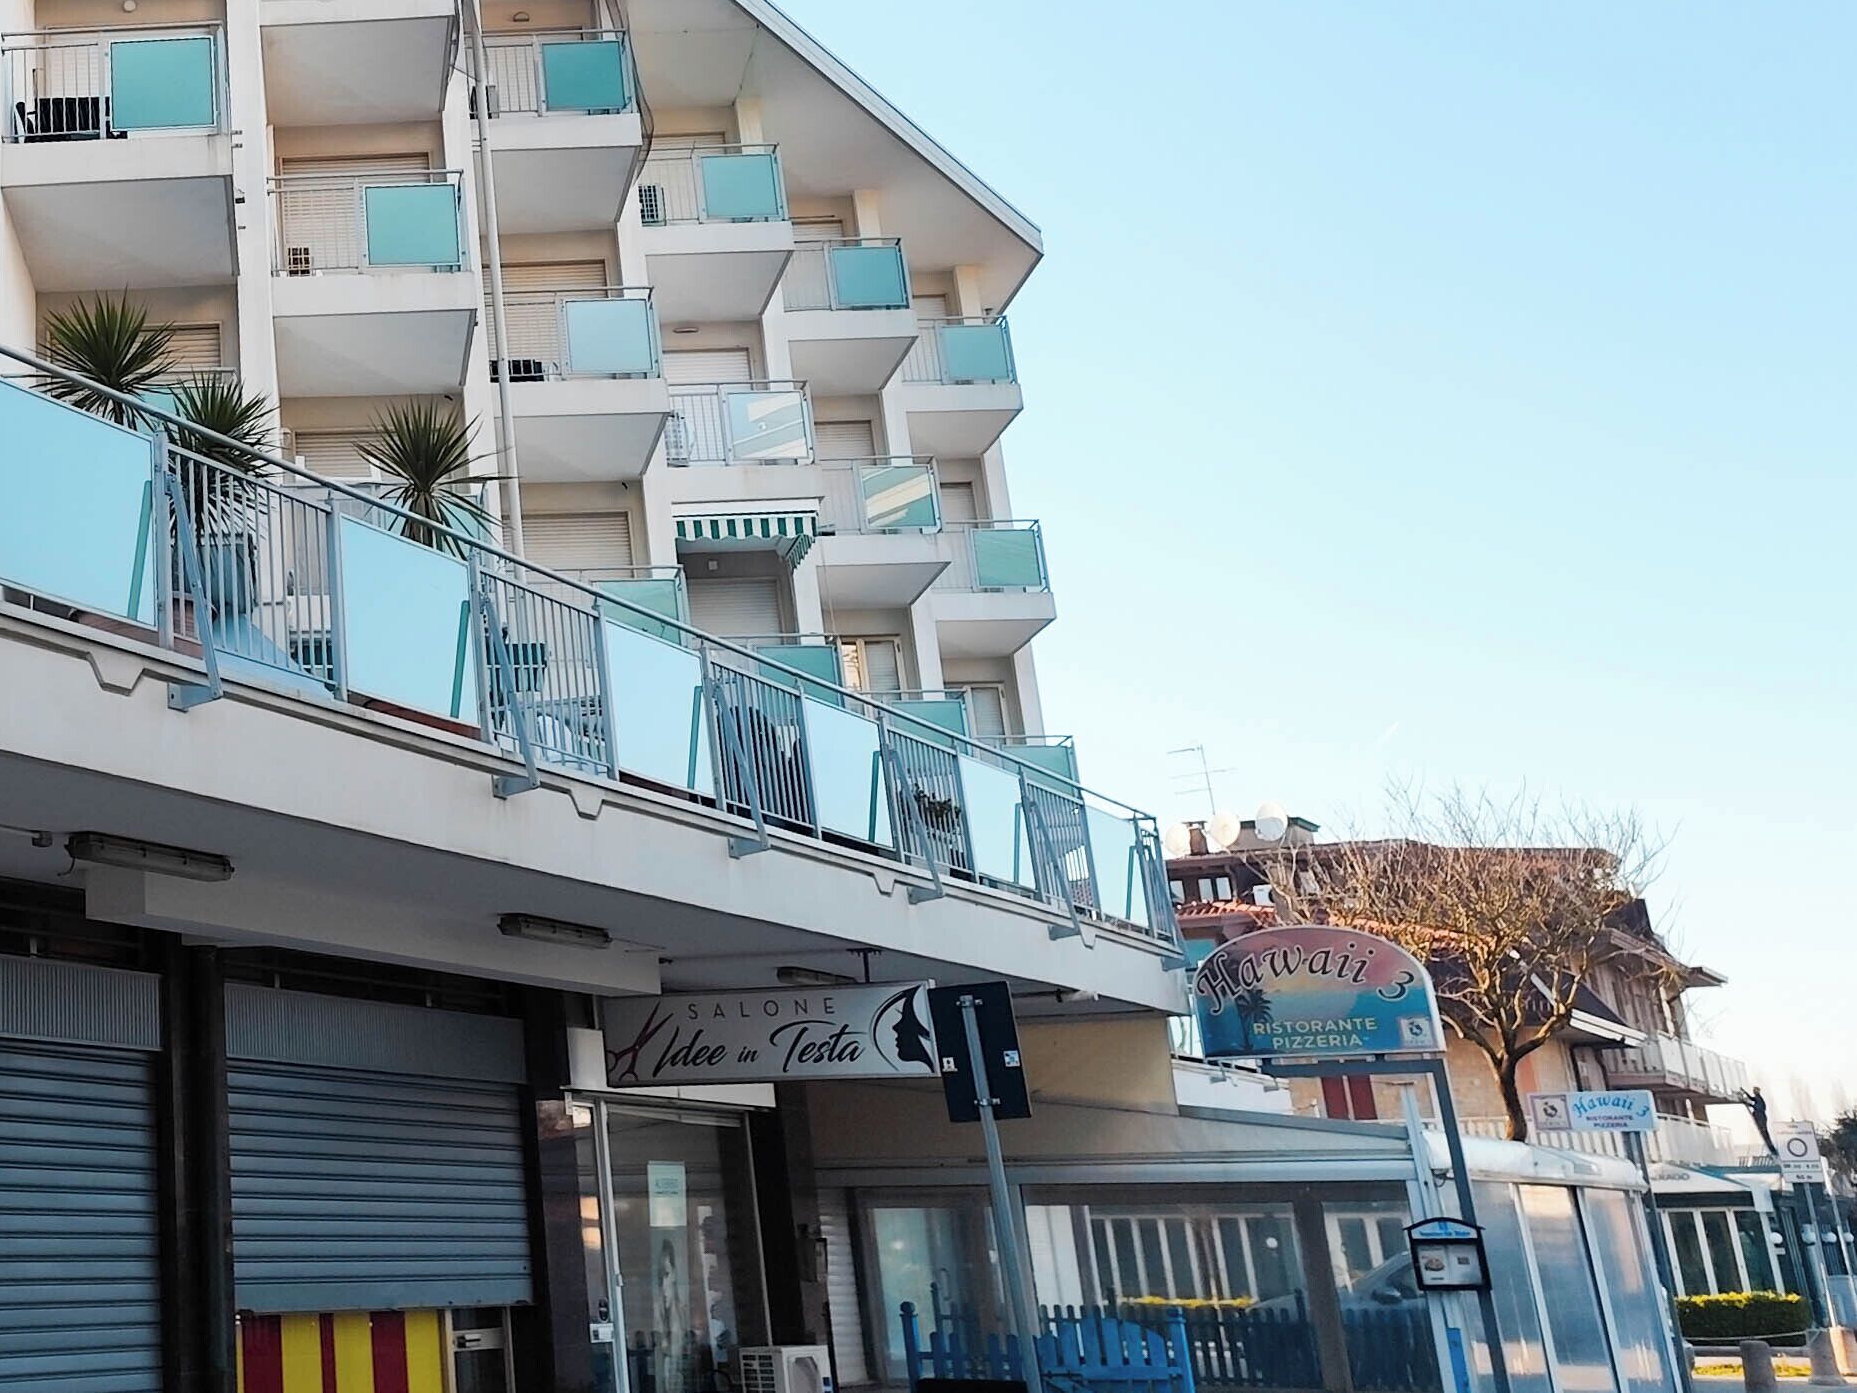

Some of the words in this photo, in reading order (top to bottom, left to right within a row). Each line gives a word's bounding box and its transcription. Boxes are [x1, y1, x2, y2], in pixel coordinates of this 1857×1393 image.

[1197, 943, 1374, 1014] Hawaii
[1377, 970, 1415, 1001] 3
[688, 996, 835, 1020] SALONE
[1253, 1017, 1378, 1036] RISTORANTE
[652, 1025, 728, 1078] Idee
[737, 1047, 759, 1064] in
[769, 1019, 869, 1073] Testa
[1273, 1033, 1364, 1050] PIZZERIA
[1573, 1093, 1636, 1118] Hawaii
[1636, 1105, 1650, 1118] 3
